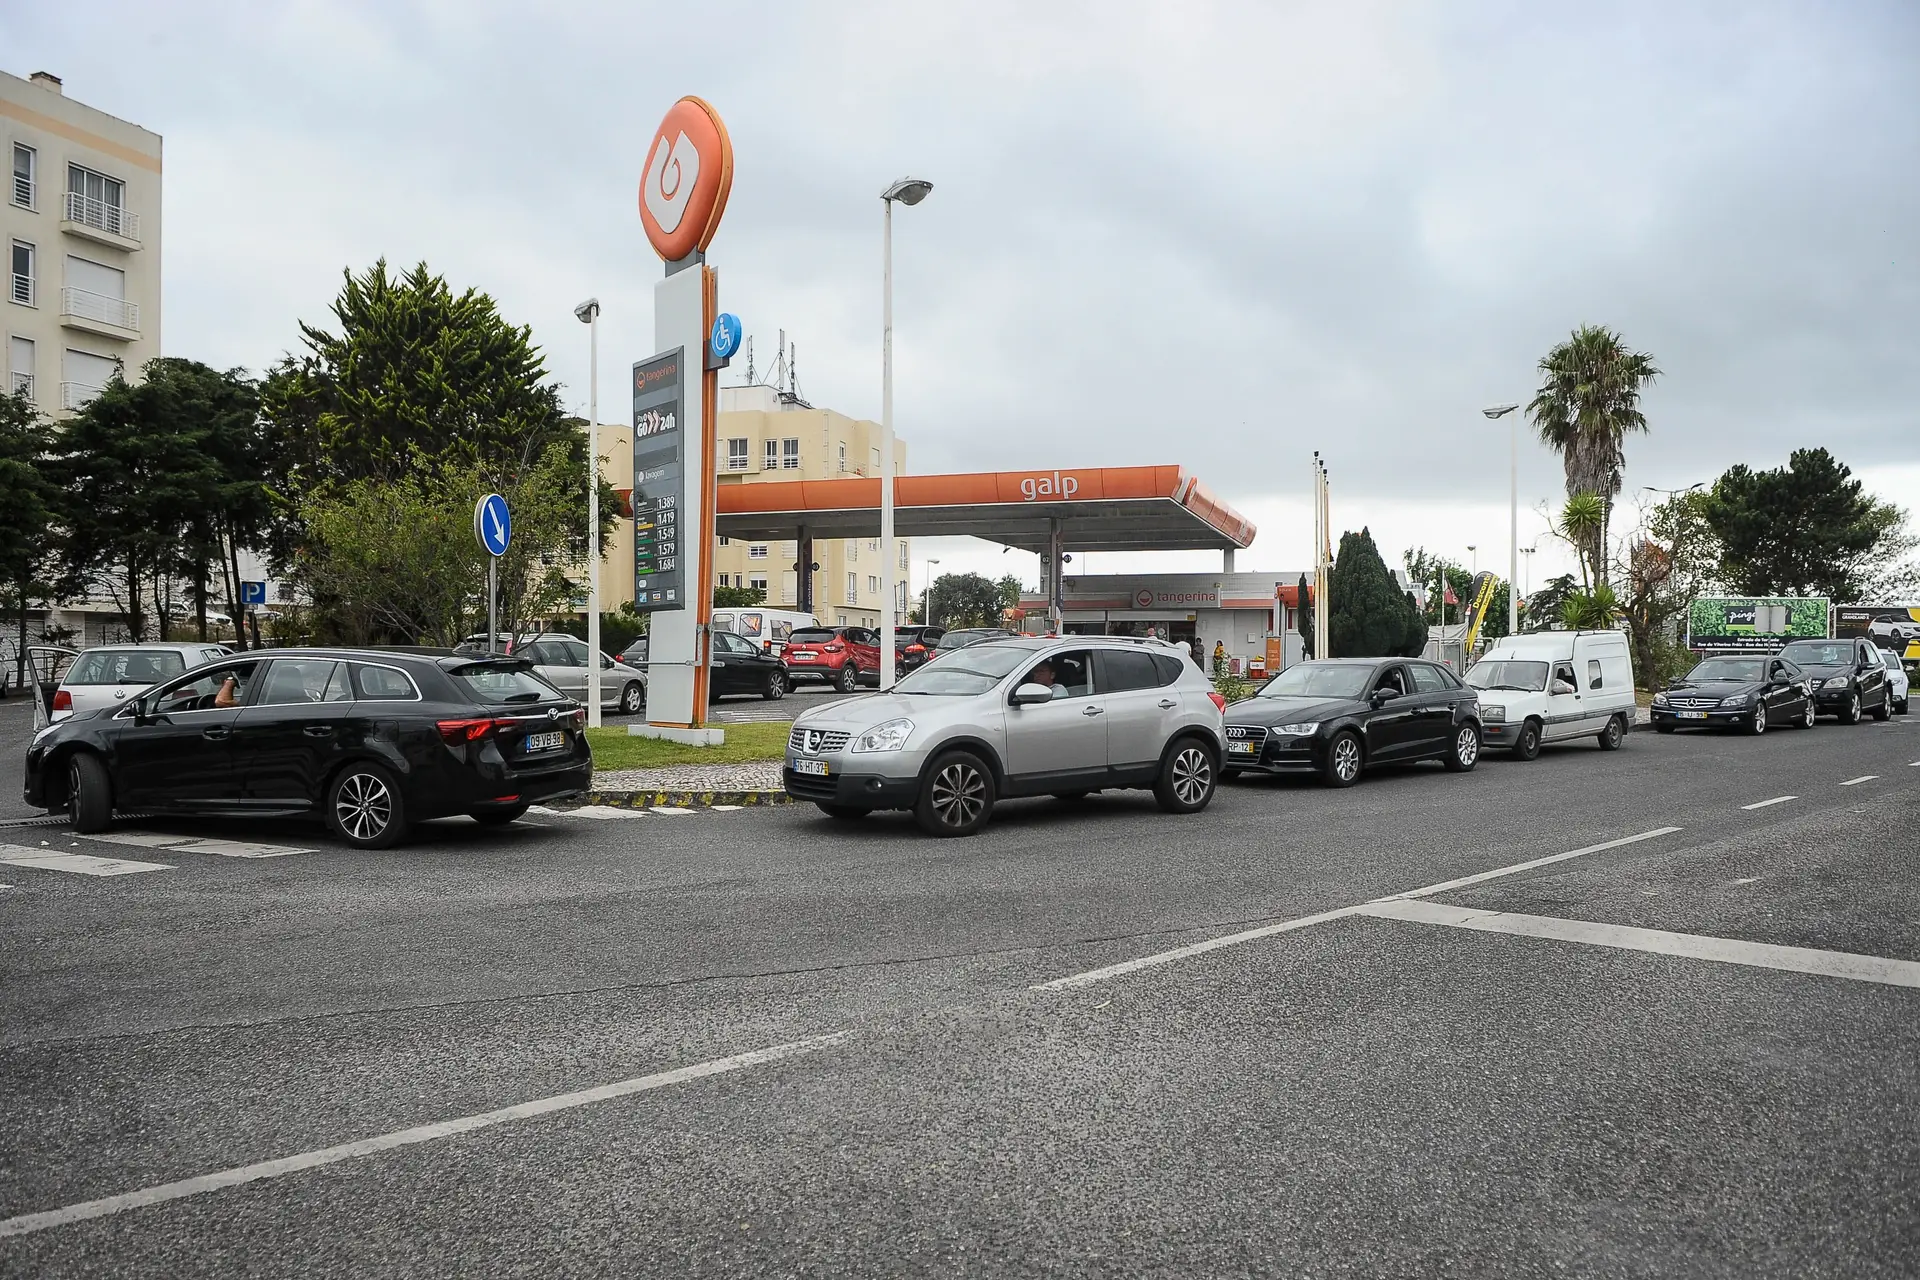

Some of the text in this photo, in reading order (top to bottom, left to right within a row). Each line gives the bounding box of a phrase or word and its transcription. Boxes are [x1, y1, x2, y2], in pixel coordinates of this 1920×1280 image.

[646, 364, 676, 381] tangerina
[660, 412, 675, 431] 24h
[1020, 471, 1078, 501] galp
[246, 582, 260, 602] P
[1157, 591, 1216, 604] tangerina
